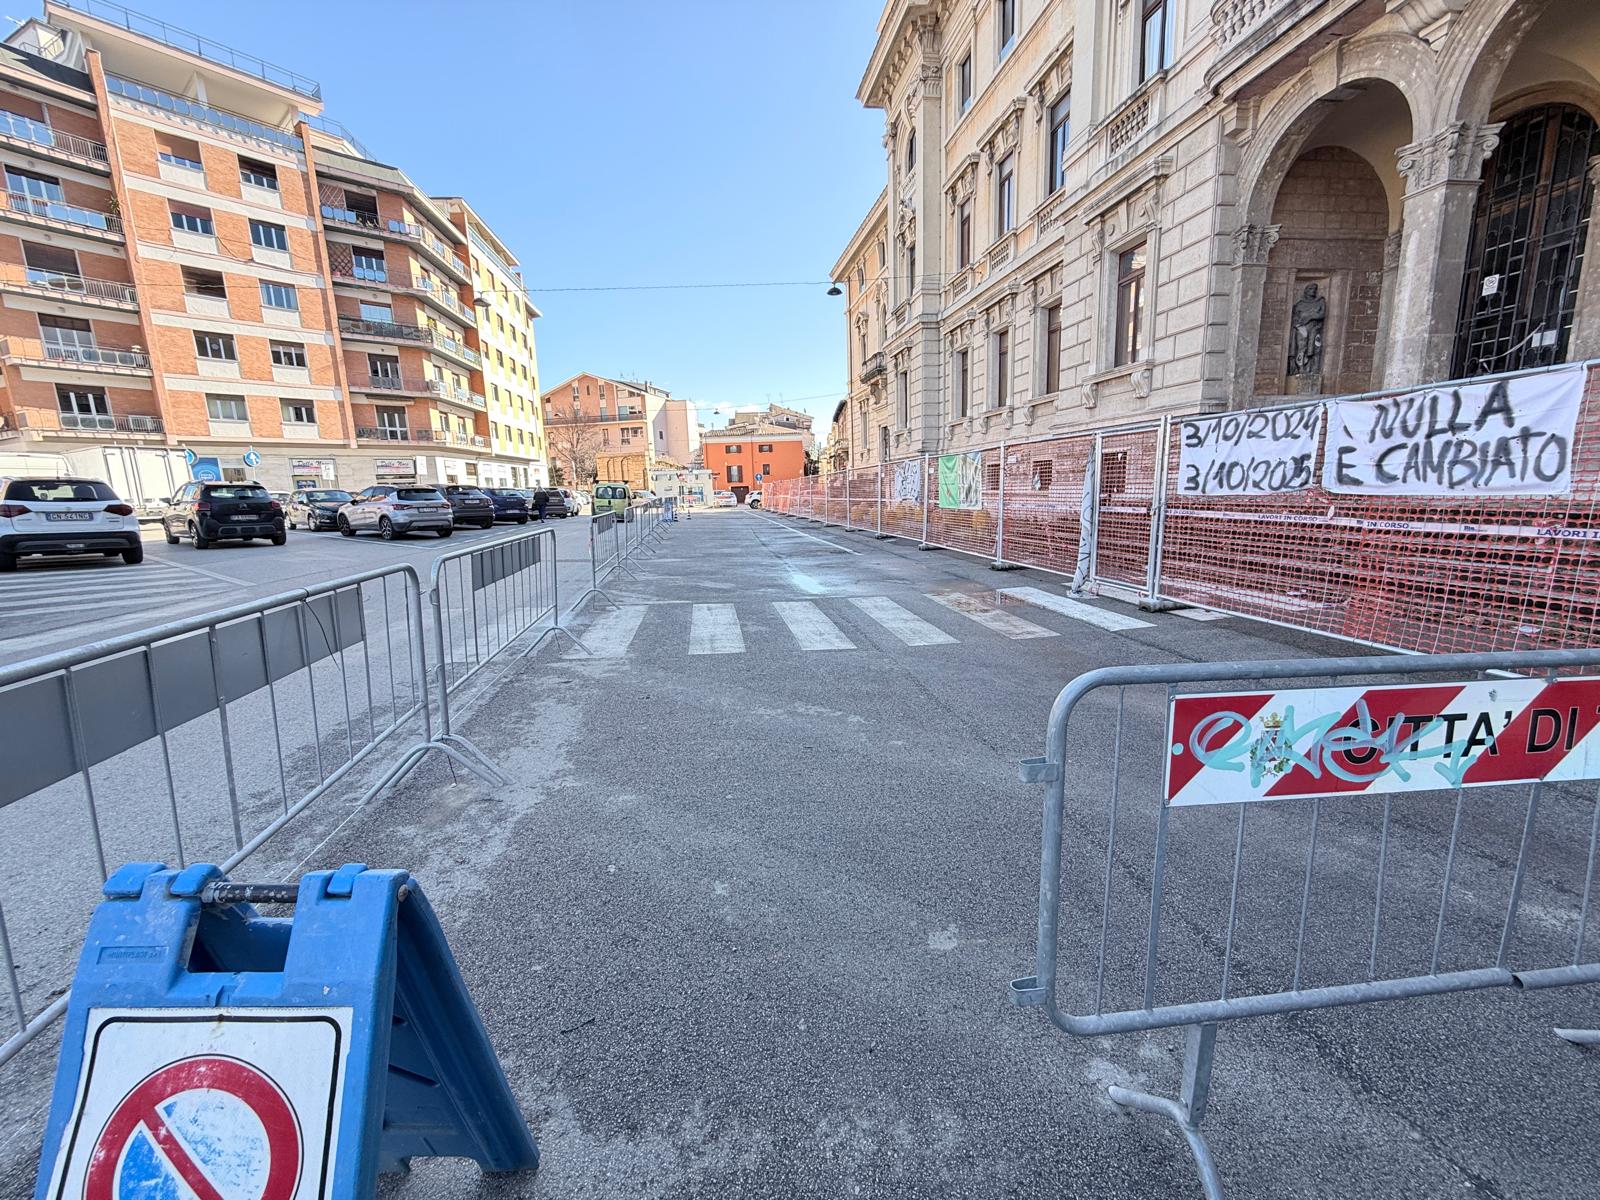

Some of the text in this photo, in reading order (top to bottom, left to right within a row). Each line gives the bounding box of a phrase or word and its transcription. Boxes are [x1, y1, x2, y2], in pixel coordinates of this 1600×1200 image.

[1183, 406, 1320, 450] 3/10/2024
[1368, 380, 1515, 443] NULLA
[1373, 426, 1568, 489] CAMBIATO
[1379, 521, 1409, 529] CORSO
[1537, 528, 1587, 538] LAVORI
[1526, 706, 1579, 754] DI
